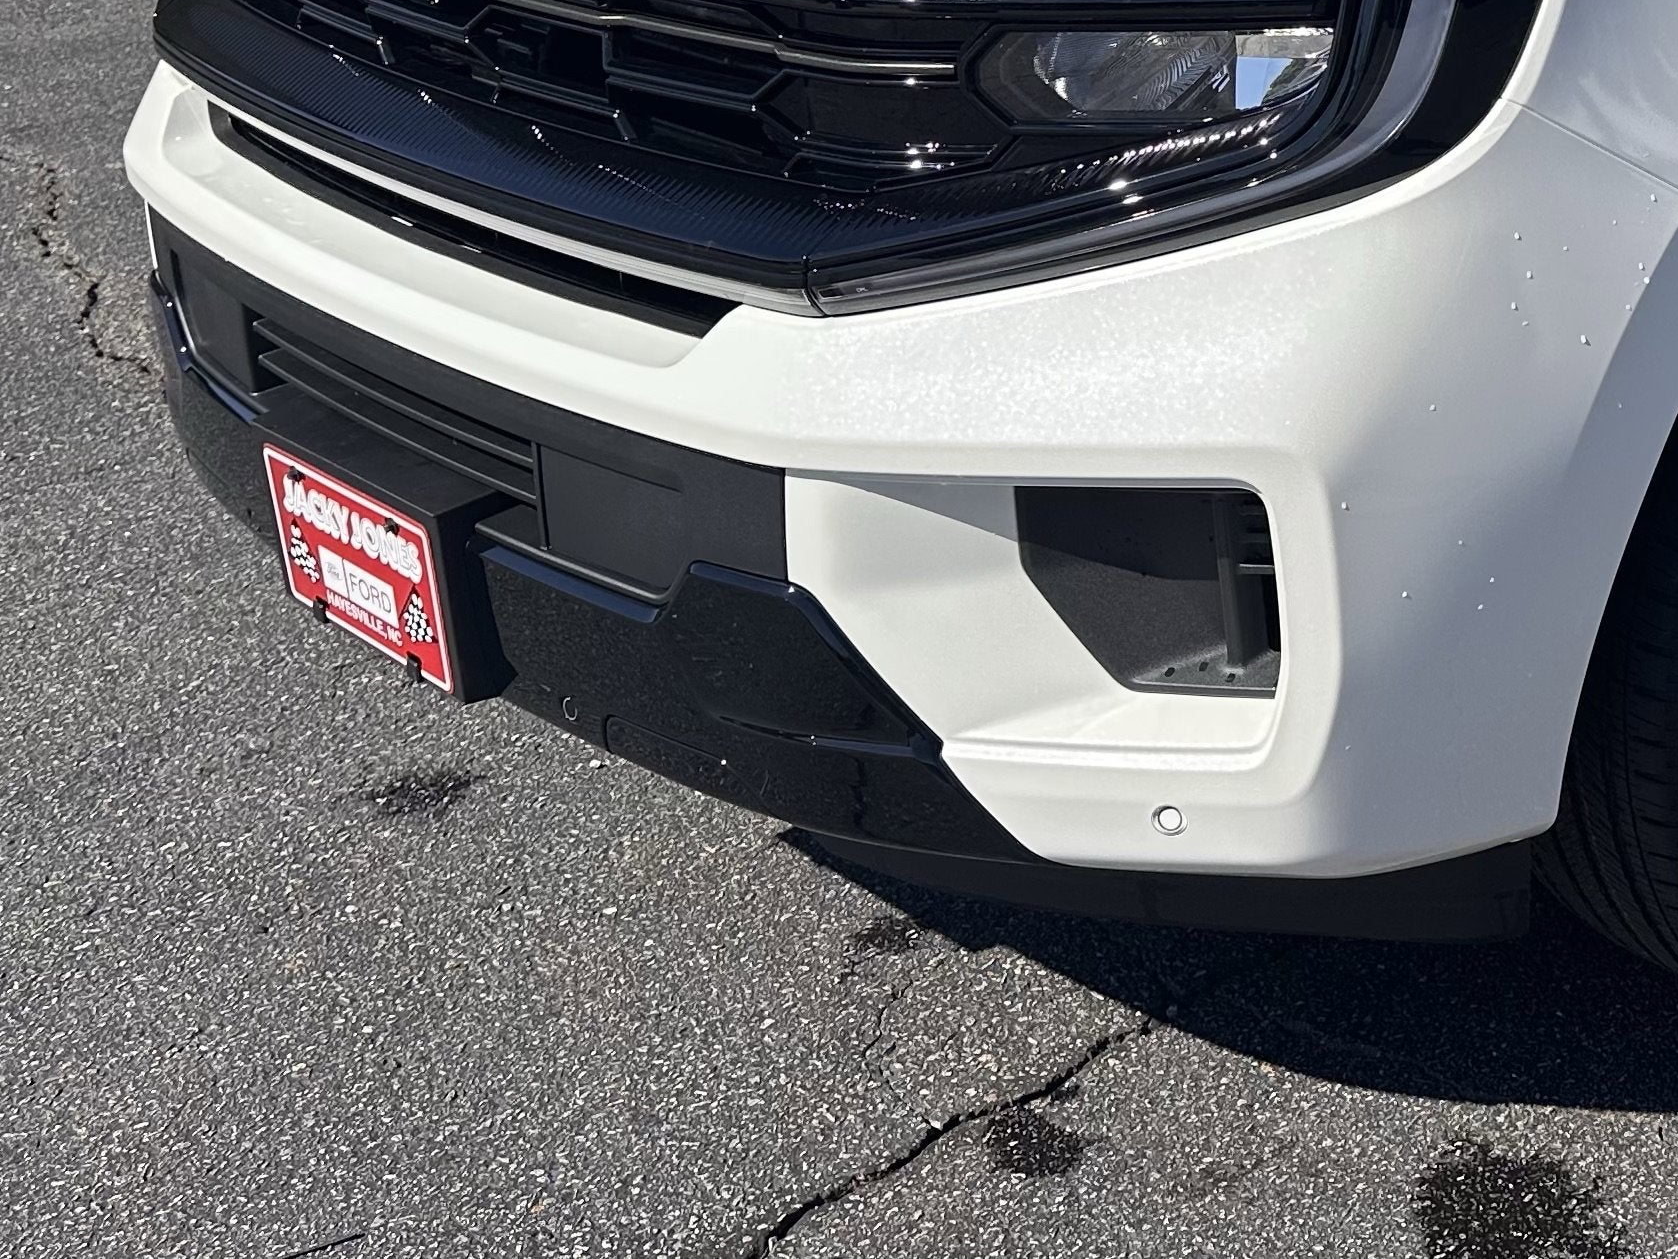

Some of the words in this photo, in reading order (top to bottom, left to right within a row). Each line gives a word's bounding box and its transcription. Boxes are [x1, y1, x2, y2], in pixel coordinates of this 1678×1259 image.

[283, 473, 350, 545] JACKY
[350, 511, 423, 584] JONES
[326, 589, 387, 638] HAYESVILLE,
[386, 625, 403, 647] NC
[349, 573, 392, 614] FORD
